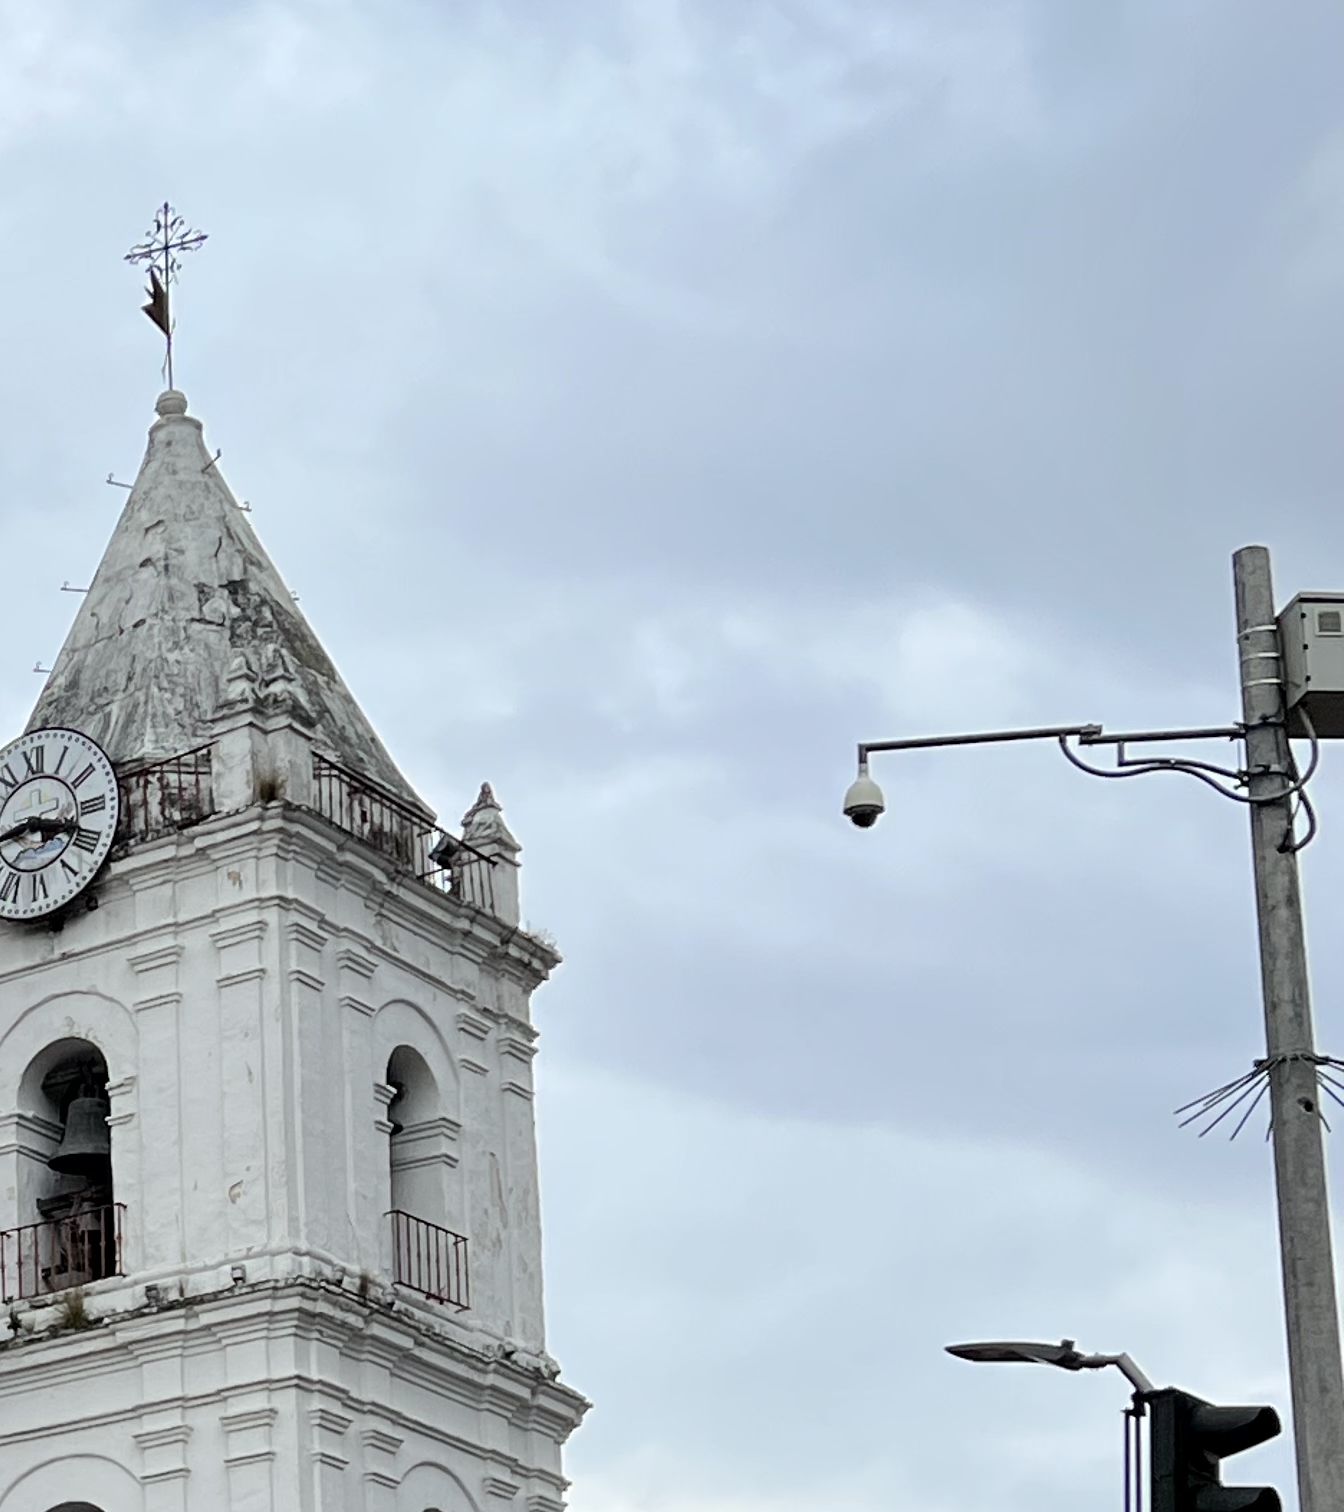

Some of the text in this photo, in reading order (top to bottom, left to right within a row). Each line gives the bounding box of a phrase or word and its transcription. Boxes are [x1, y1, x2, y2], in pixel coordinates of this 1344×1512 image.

[21, 745, 45, 778] XII
[54, 745, 69, 775] I
[71, 762, 96, 789] II
[80, 794, 106, 816] III
